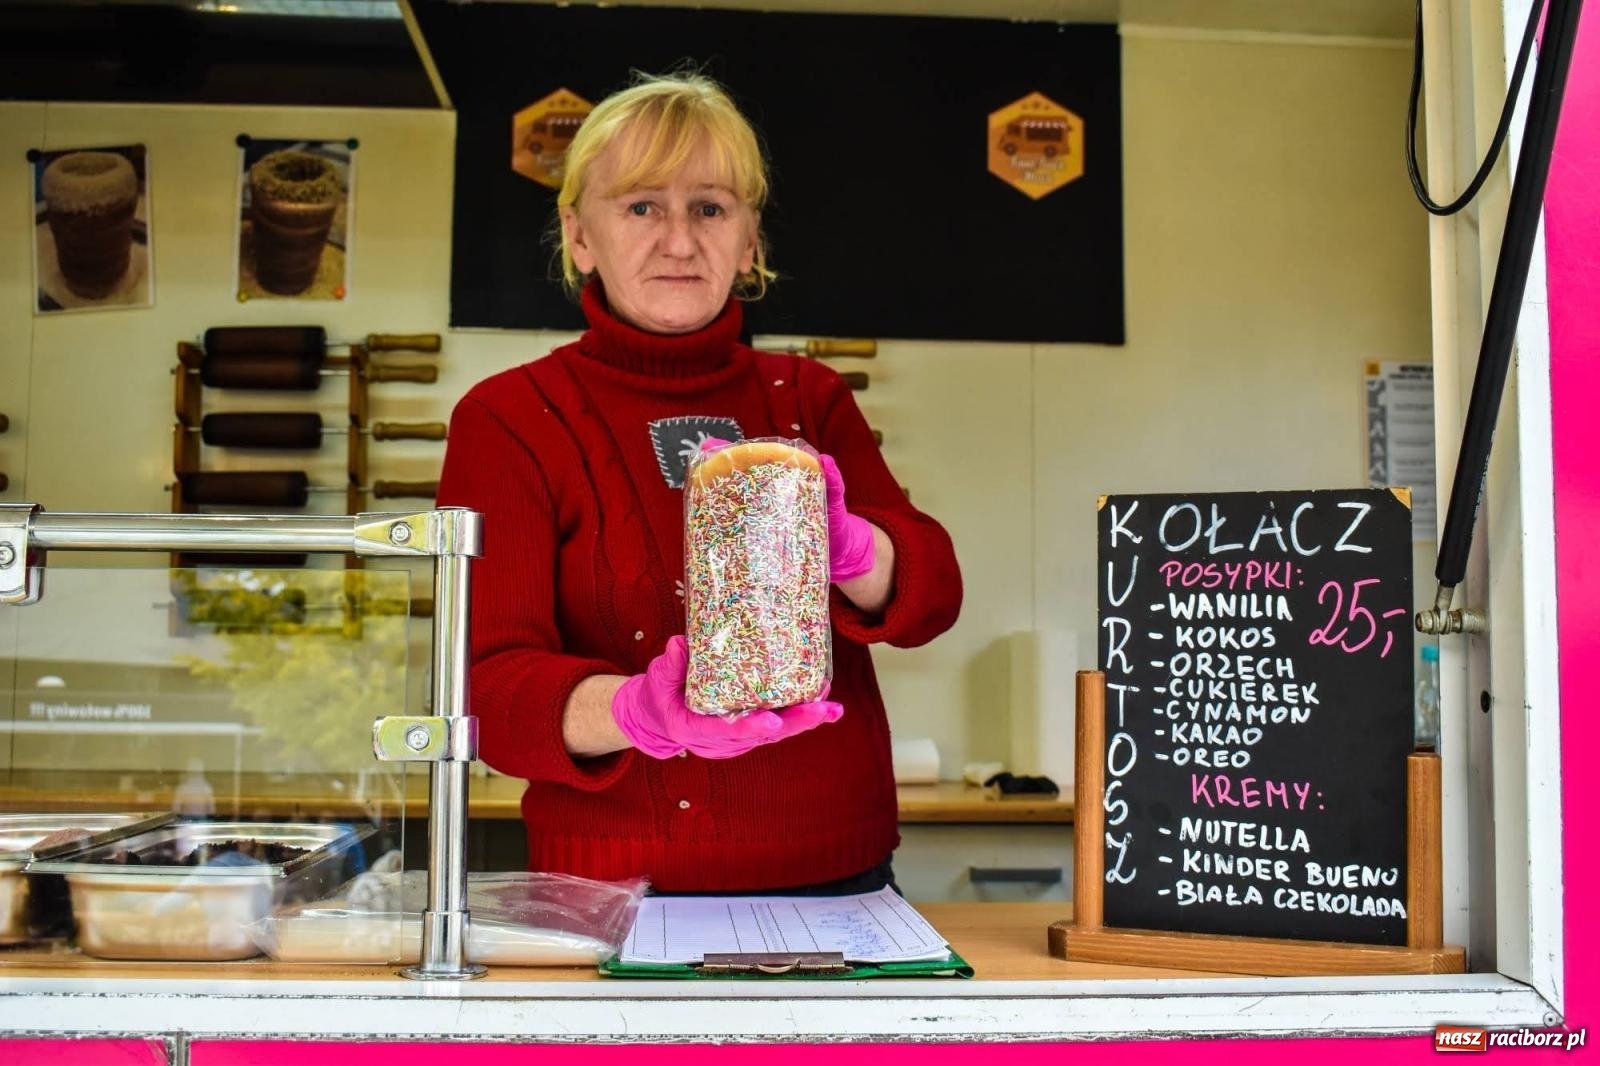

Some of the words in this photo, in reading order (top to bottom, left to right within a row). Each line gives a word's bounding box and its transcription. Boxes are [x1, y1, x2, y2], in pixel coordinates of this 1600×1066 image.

[1158, 560, 1305, 590] POSYPKI:
[1175, 626, 1277, 650] KOKOS
[1191, 773, 1325, 811] KREMY:
[1179, 817, 1311, 853] NUTELLA
[1183, 849, 1291, 883] KINDER
[1273, 888, 1408, 919] CZEKOLADA
